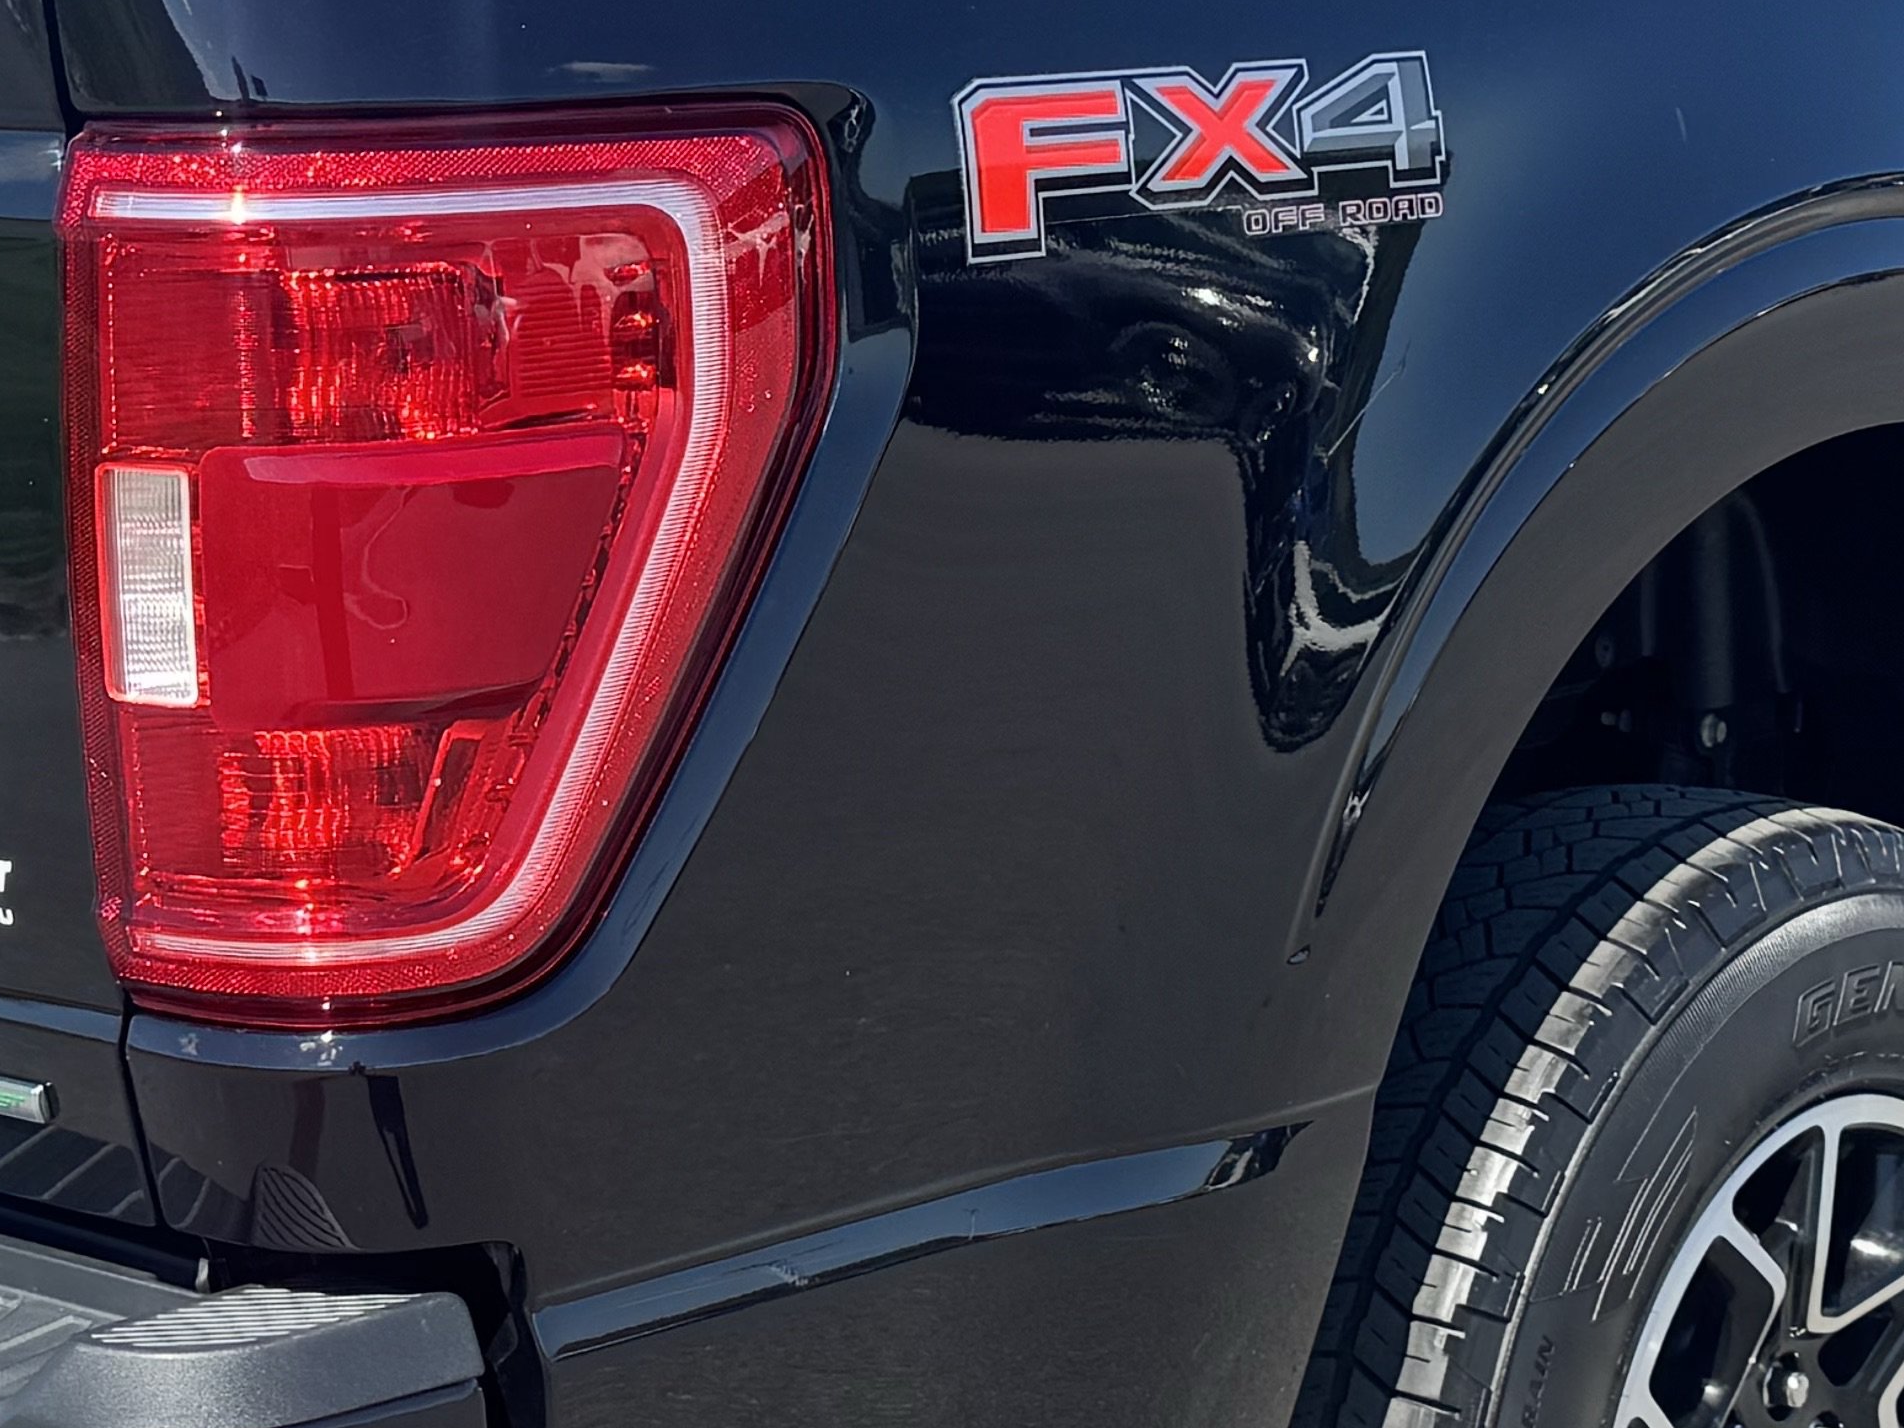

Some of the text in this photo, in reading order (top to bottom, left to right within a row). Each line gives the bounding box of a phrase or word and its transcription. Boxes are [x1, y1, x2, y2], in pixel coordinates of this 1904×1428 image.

[952, 51, 1445, 264] FX4
[1243, 190, 1444, 237] OFF ROAD
